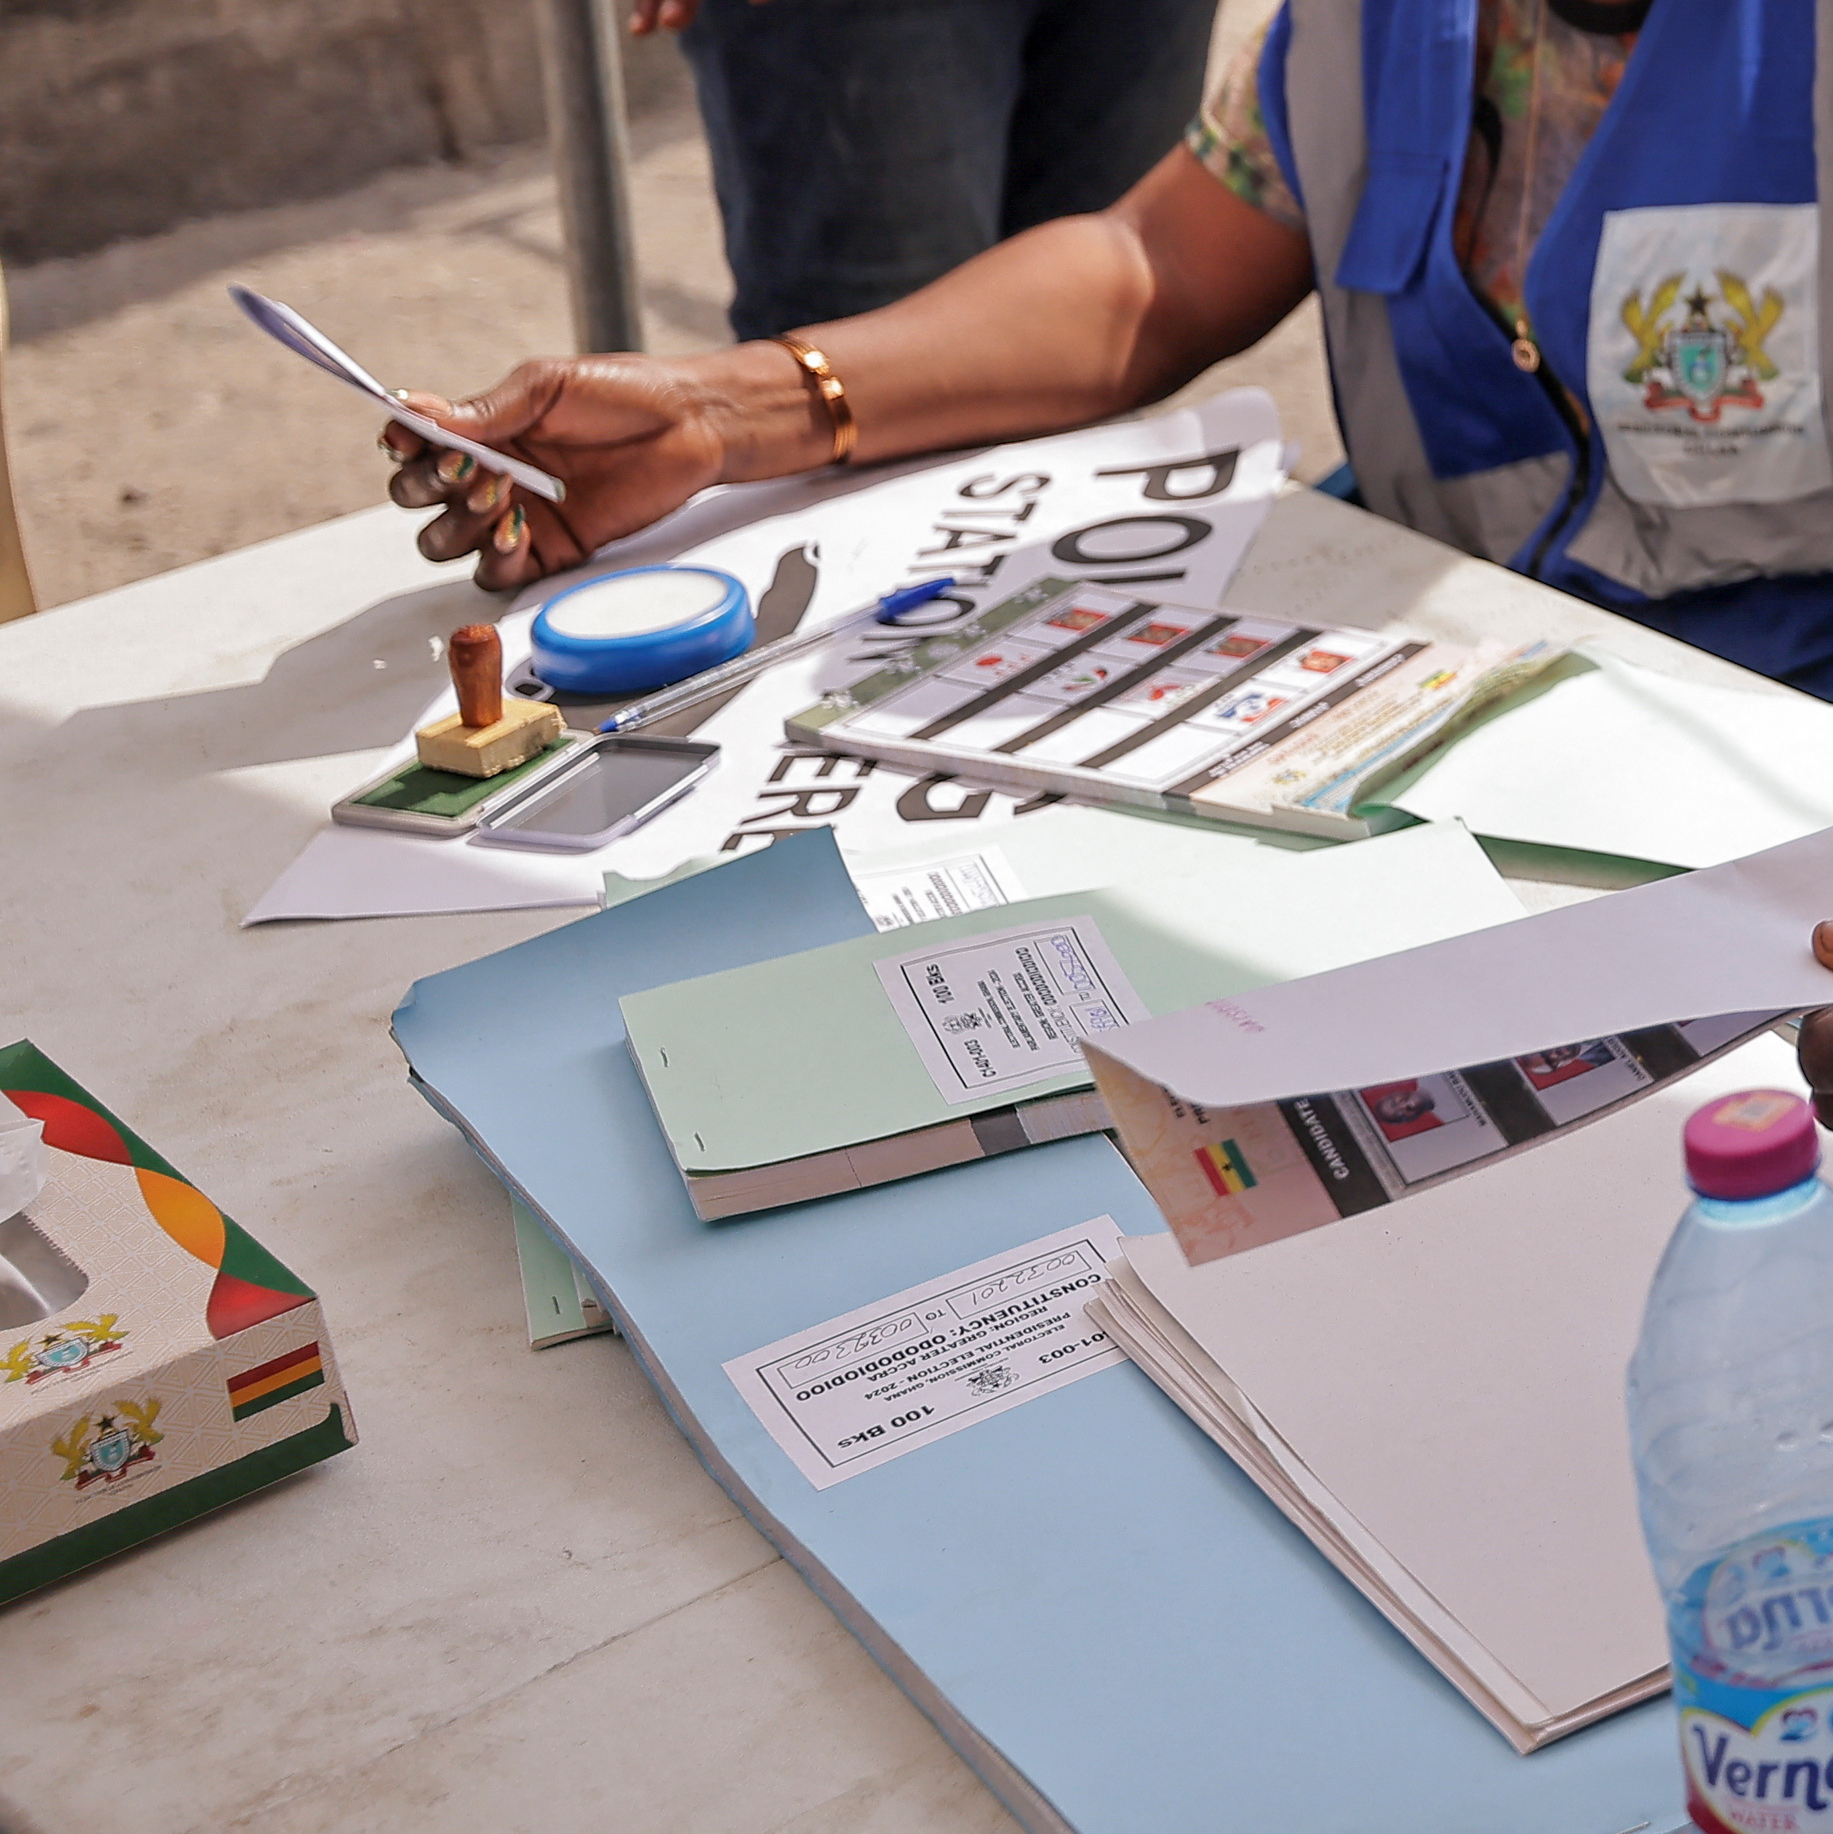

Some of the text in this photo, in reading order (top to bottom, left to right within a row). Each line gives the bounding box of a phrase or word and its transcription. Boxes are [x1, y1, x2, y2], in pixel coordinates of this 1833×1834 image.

[920, 963, 956, 1004] 100 Bks
[1292, 1097, 1350, 1181] CANDIDATE
[967, 1250, 1079, 1305] 0032201
[923, 1307, 946, 1322] TO
[974, 1310, 1071, 1354] PRESIDENTIAL
[792, 1270, 1101, 1402] CONSTITUENCY: ODODODIODIOO
[866, 1304, 1048, 1382] REGION: GREATER ACCRA
[1001, 1323, 1065, 1353] ELECTORAL
[905, 1350, 975, 1382] ELECTION
[862, 1382, 898, 1400] 2024
[882, 1381, 925, 1402] GHANA
[834, 1403, 936, 1451] 100 Bks
